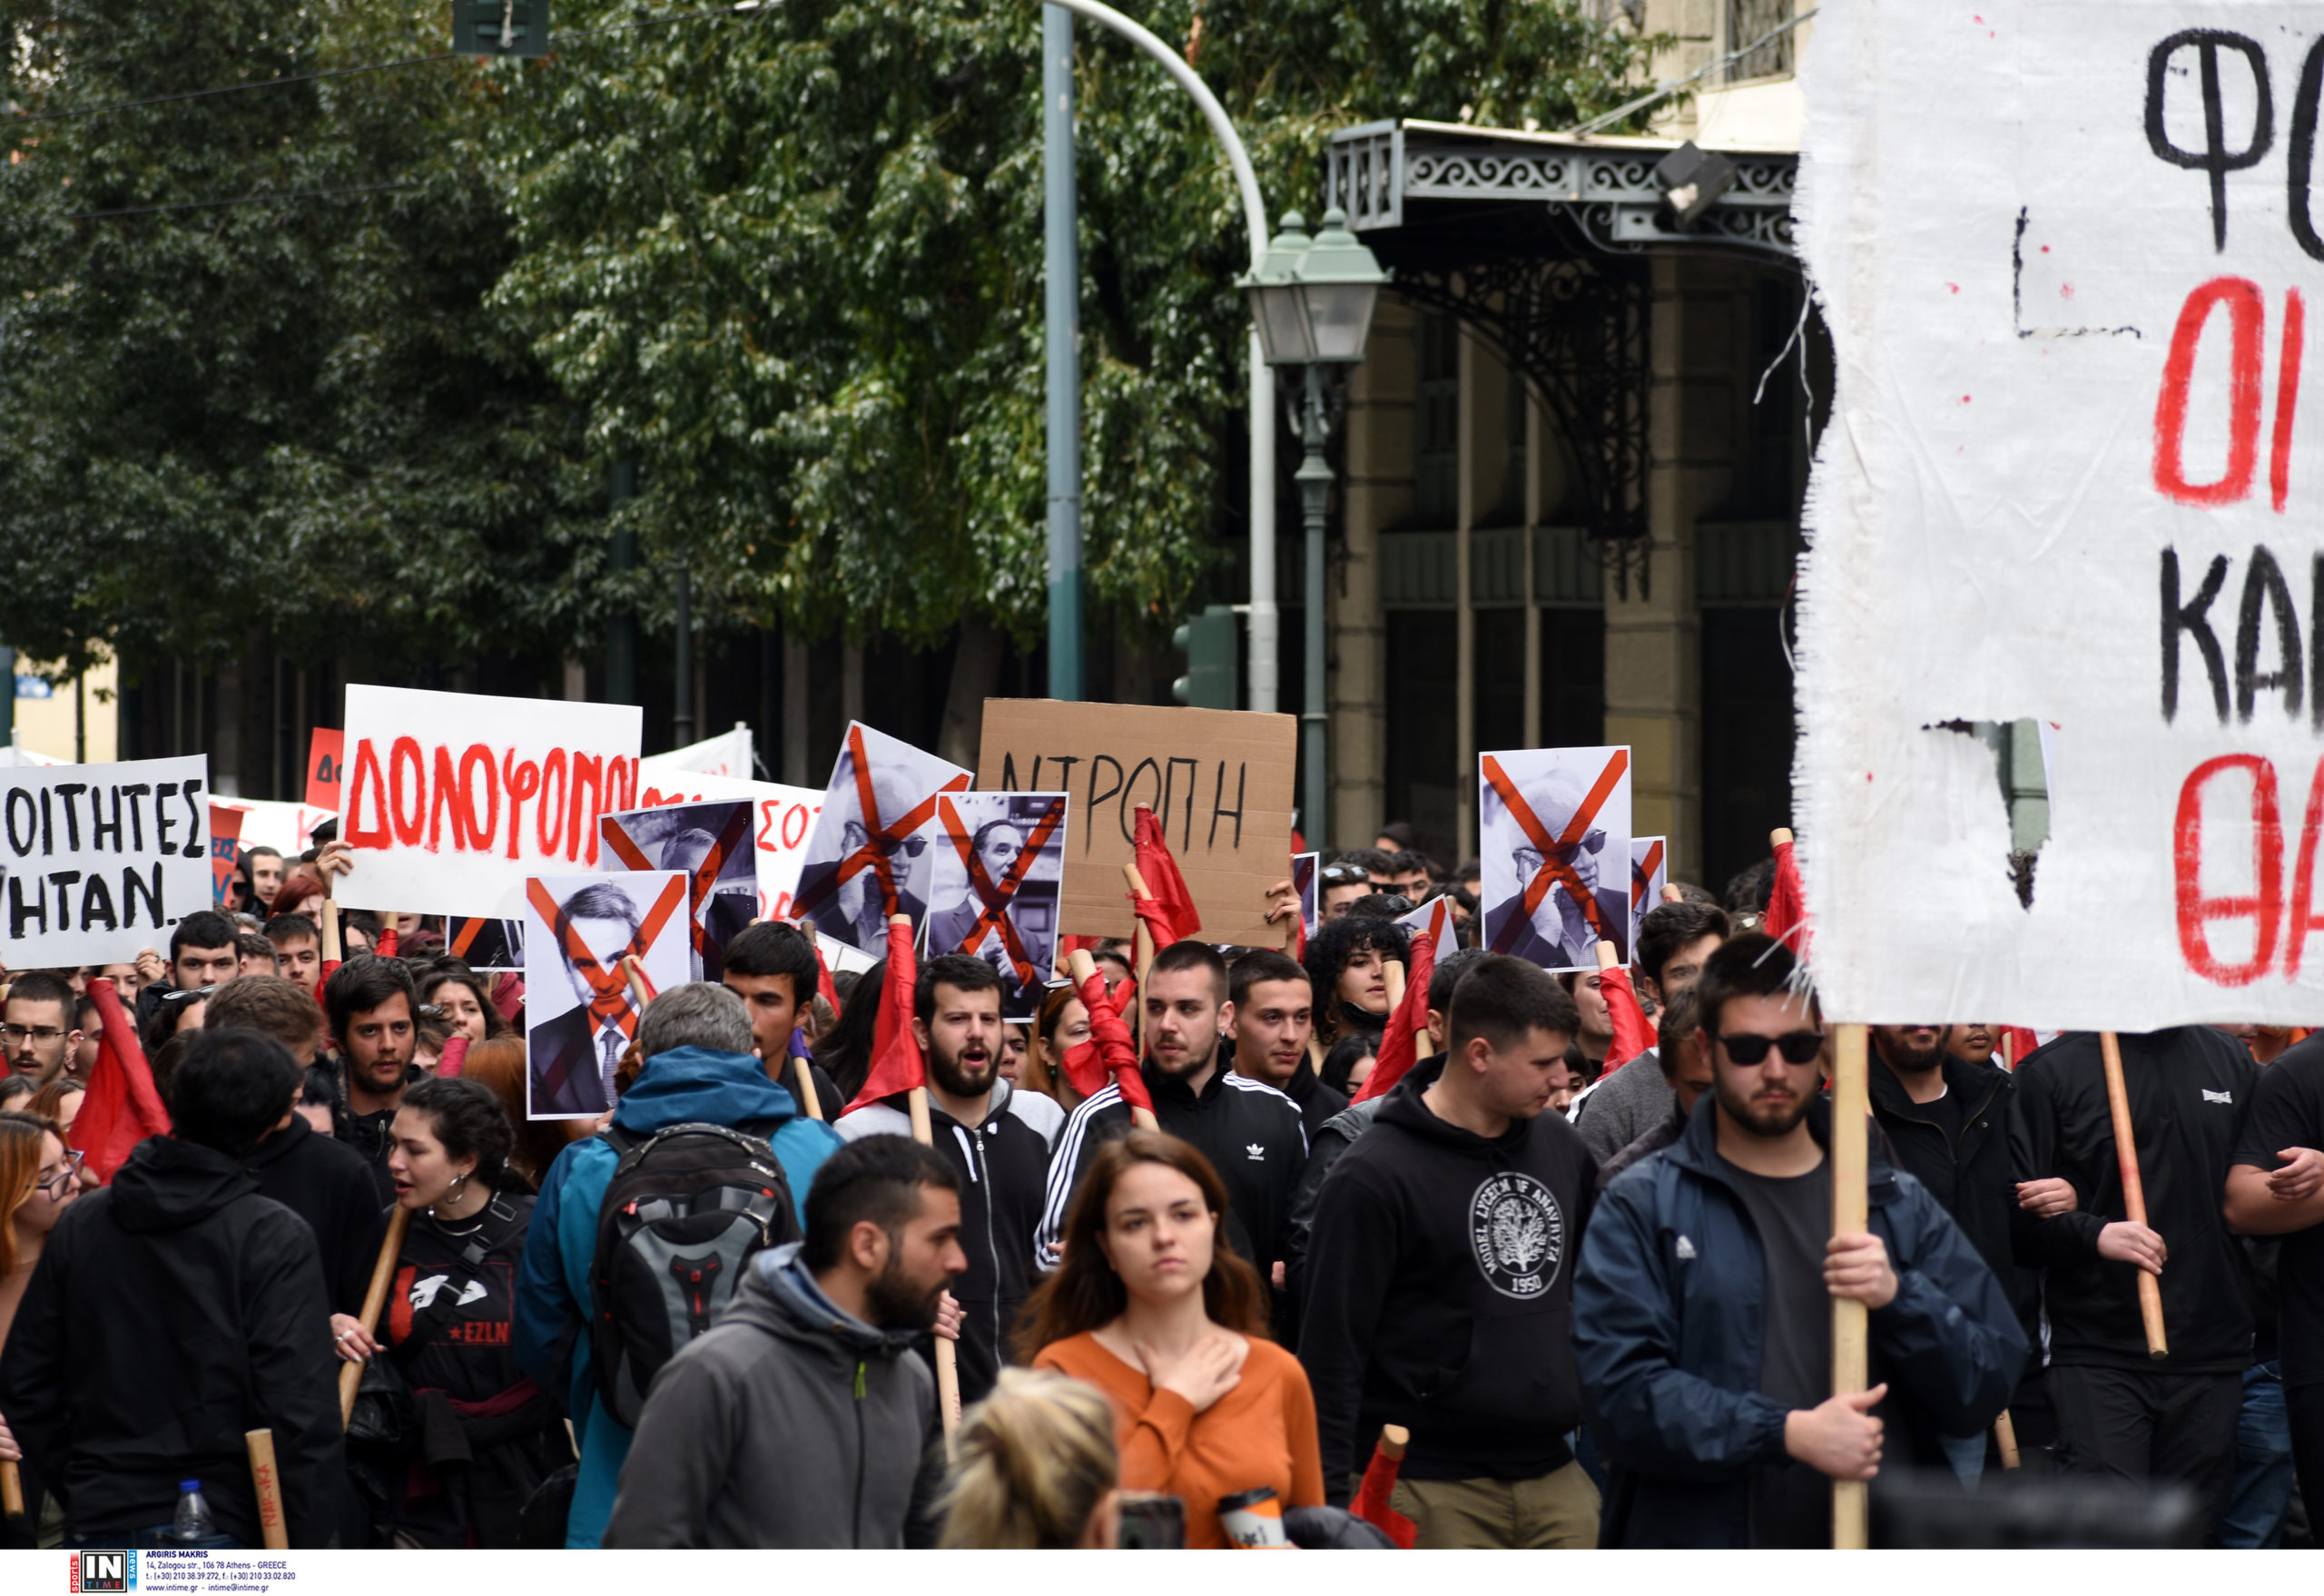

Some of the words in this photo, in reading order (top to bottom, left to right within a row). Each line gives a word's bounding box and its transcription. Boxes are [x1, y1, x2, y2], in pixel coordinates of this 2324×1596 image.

[2152, 275, 2305, 515] ΟΙ
[2159, 541, 2324, 737] ΚΑ
[1475, 1225, 1498, 1275] MODEL
[464, 1321, 509, 1343] EZLN
